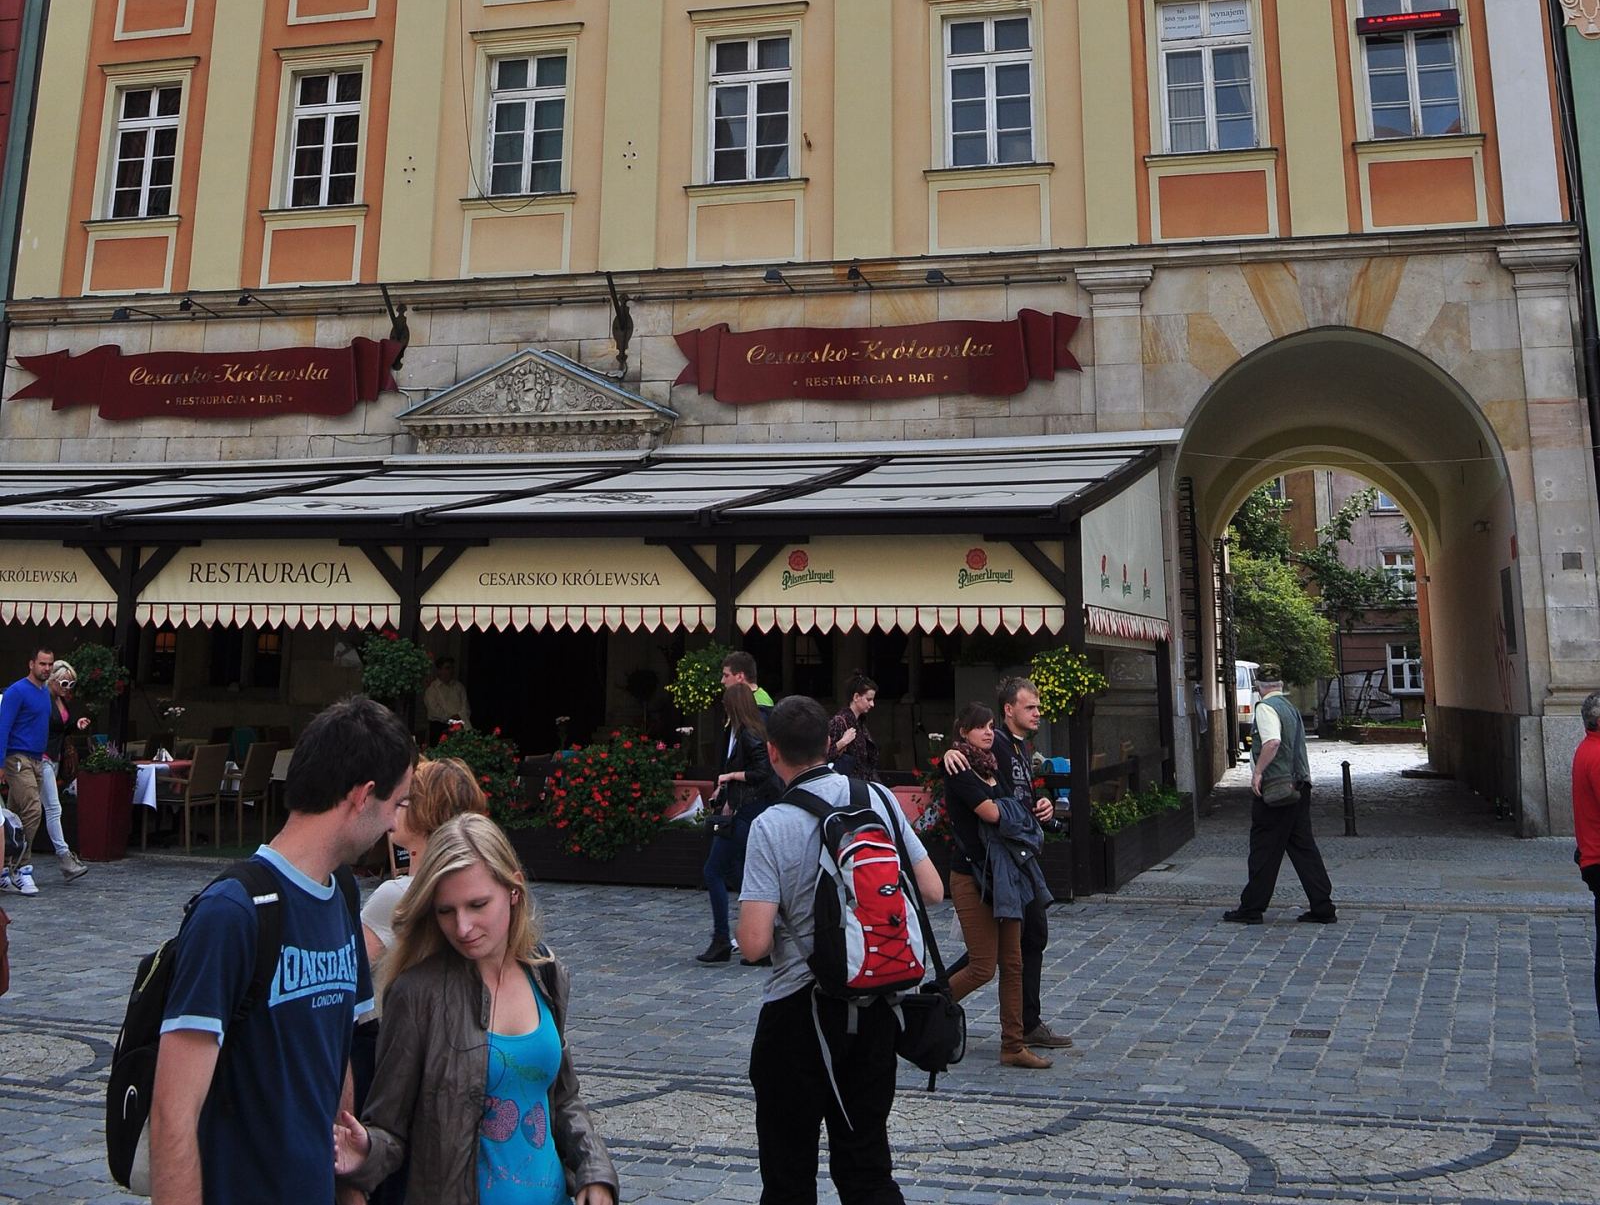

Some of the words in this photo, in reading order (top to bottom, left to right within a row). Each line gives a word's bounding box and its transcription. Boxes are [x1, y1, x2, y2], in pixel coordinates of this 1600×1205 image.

[1210, 8, 1245, 19] wynajem
[805, 373, 893, 387] RESTAURACJA
[908, 373, 936, 383] BAR
[175, 394, 246, 406] RESTAURACJA
[259, 394, 283, 404] BAR
[0, 566, 78, 583] KRÓLEWSKA
[189, 561, 353, 588] RESTAURACJA
[478, 571, 558, 587] CESARSKO
[561, 568, 661, 587] KRÓLEWSKA
[311, 992, 345, 1009] LONDON
